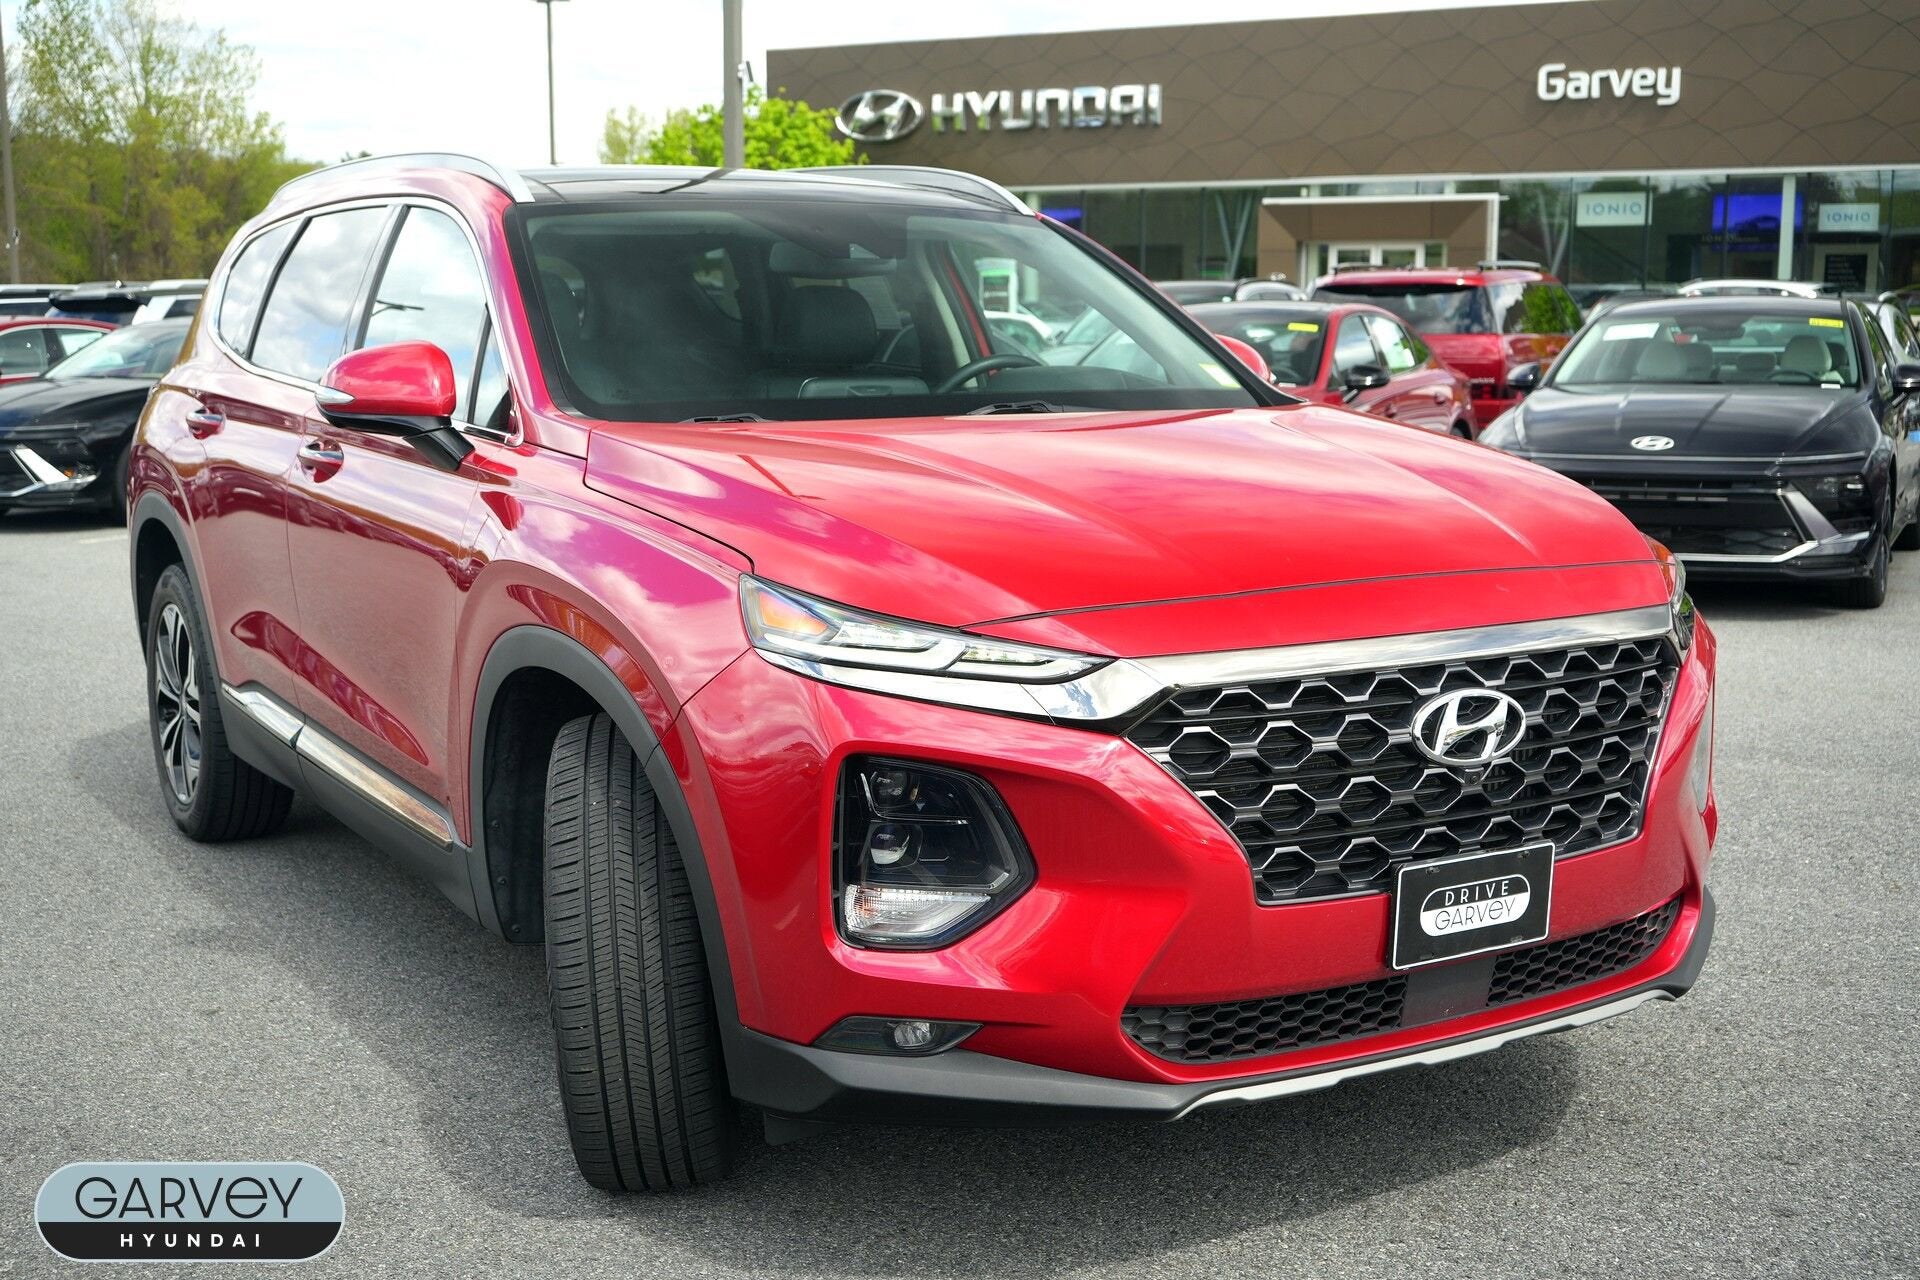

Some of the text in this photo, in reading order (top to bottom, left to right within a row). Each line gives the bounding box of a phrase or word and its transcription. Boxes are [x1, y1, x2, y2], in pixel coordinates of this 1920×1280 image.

[1537, 63, 1682, 106] Garvey
[931, 83, 1162, 131] HYUNDAI
[1445, 880, 1510, 906] DRIVE
